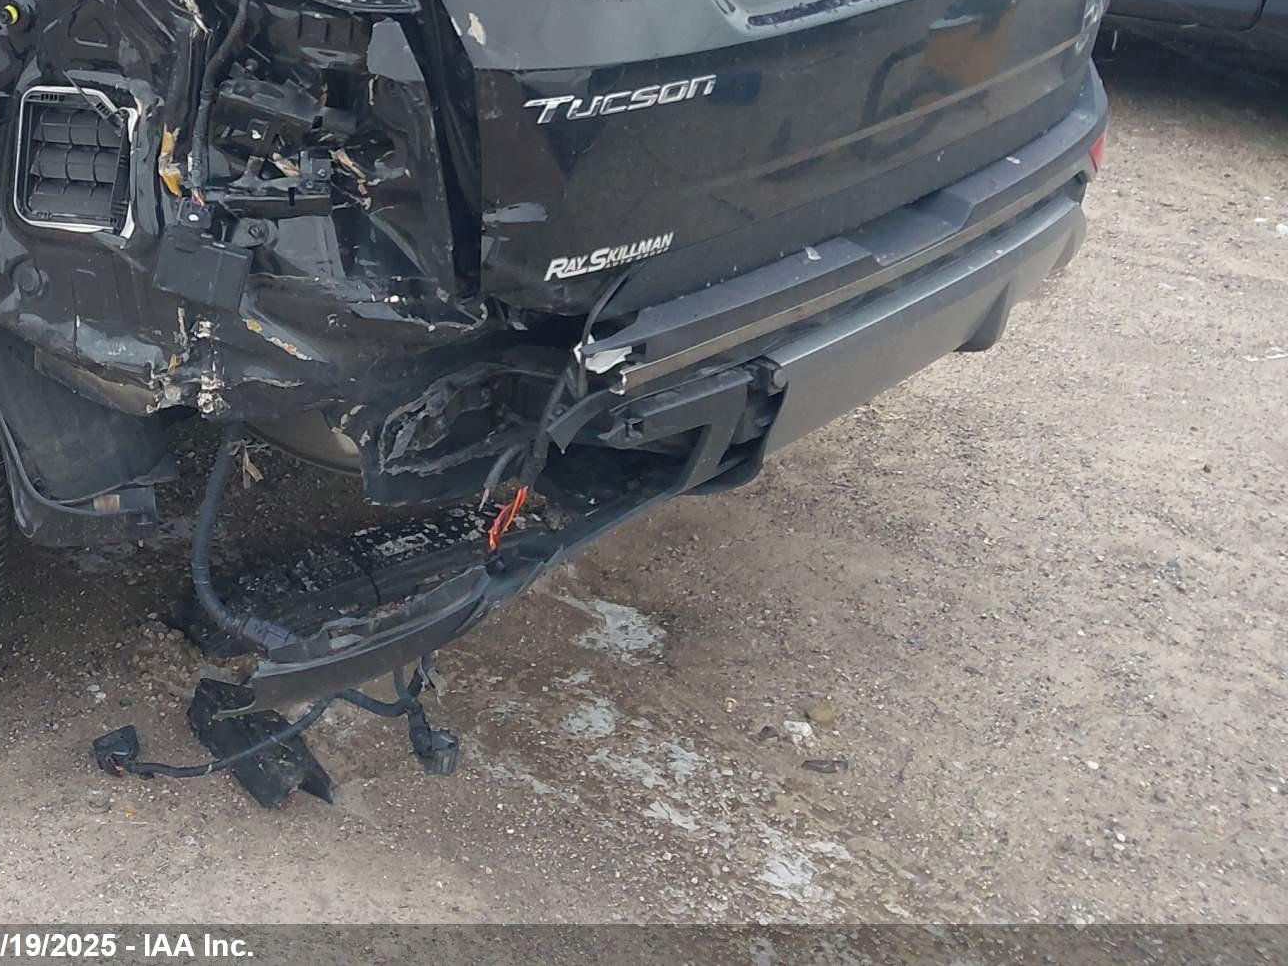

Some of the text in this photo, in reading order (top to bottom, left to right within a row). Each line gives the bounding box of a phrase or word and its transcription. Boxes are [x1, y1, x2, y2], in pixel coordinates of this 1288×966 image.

[523, 74, 717, 124] TUCSON
[543, 254, 589, 282] RAY
[587, 232, 674, 271] SKILLMAN
